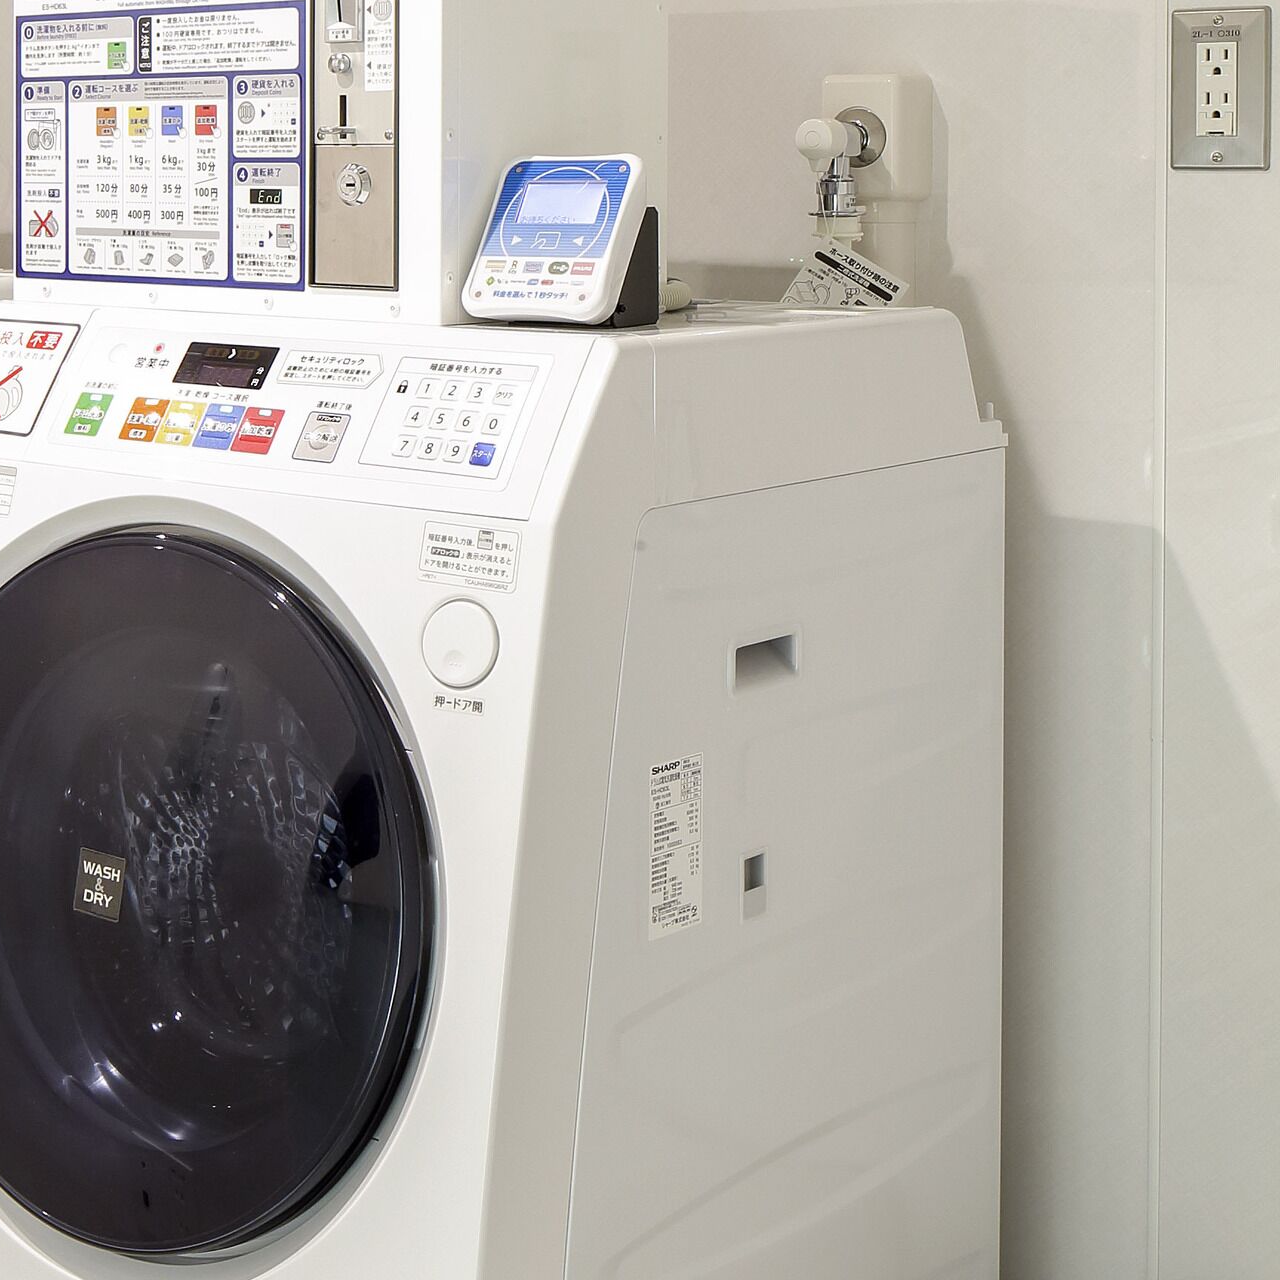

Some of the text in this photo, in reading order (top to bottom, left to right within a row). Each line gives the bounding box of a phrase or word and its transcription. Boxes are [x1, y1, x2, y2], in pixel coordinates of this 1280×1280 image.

[1192, 29, 1213, 38] 2L-1
[195, 187, 218, 198] 100円
[258, 190, 281, 203] End
[96, 209, 118, 219] 500円
[128, 210, 150, 220] 400円
[161, 210, 183, 221] 300円
[829, 247, 900, 294] ホース取り付け時の注意
[29, 331, 61, 349] 不要
[300, 355, 365, 365] セキュリティロック
[430, 363, 502, 376] 暗証番号を入力する
[425, 383, 431, 393] 1
[448, 385, 457, 396] 2
[473, 387, 483, 398] 3
[411, 411, 419, 422] 4
[436, 413, 445, 425] 5
[462, 416, 470, 427] 6
[304, 432, 339, 443] ロク解除
[400, 440, 409, 451] 7
[424, 442, 434, 454] 8
[451, 445, 460, 457] 9
[495, 541, 514, 552] を押し
[423, 559, 510, 578] ドアを開けることができます。
[651, 760, 681, 776] SHARP
[83, 860, 120, 883] WASH
[94, 877, 105, 893] &
[83, 888, 114, 908] DRY
